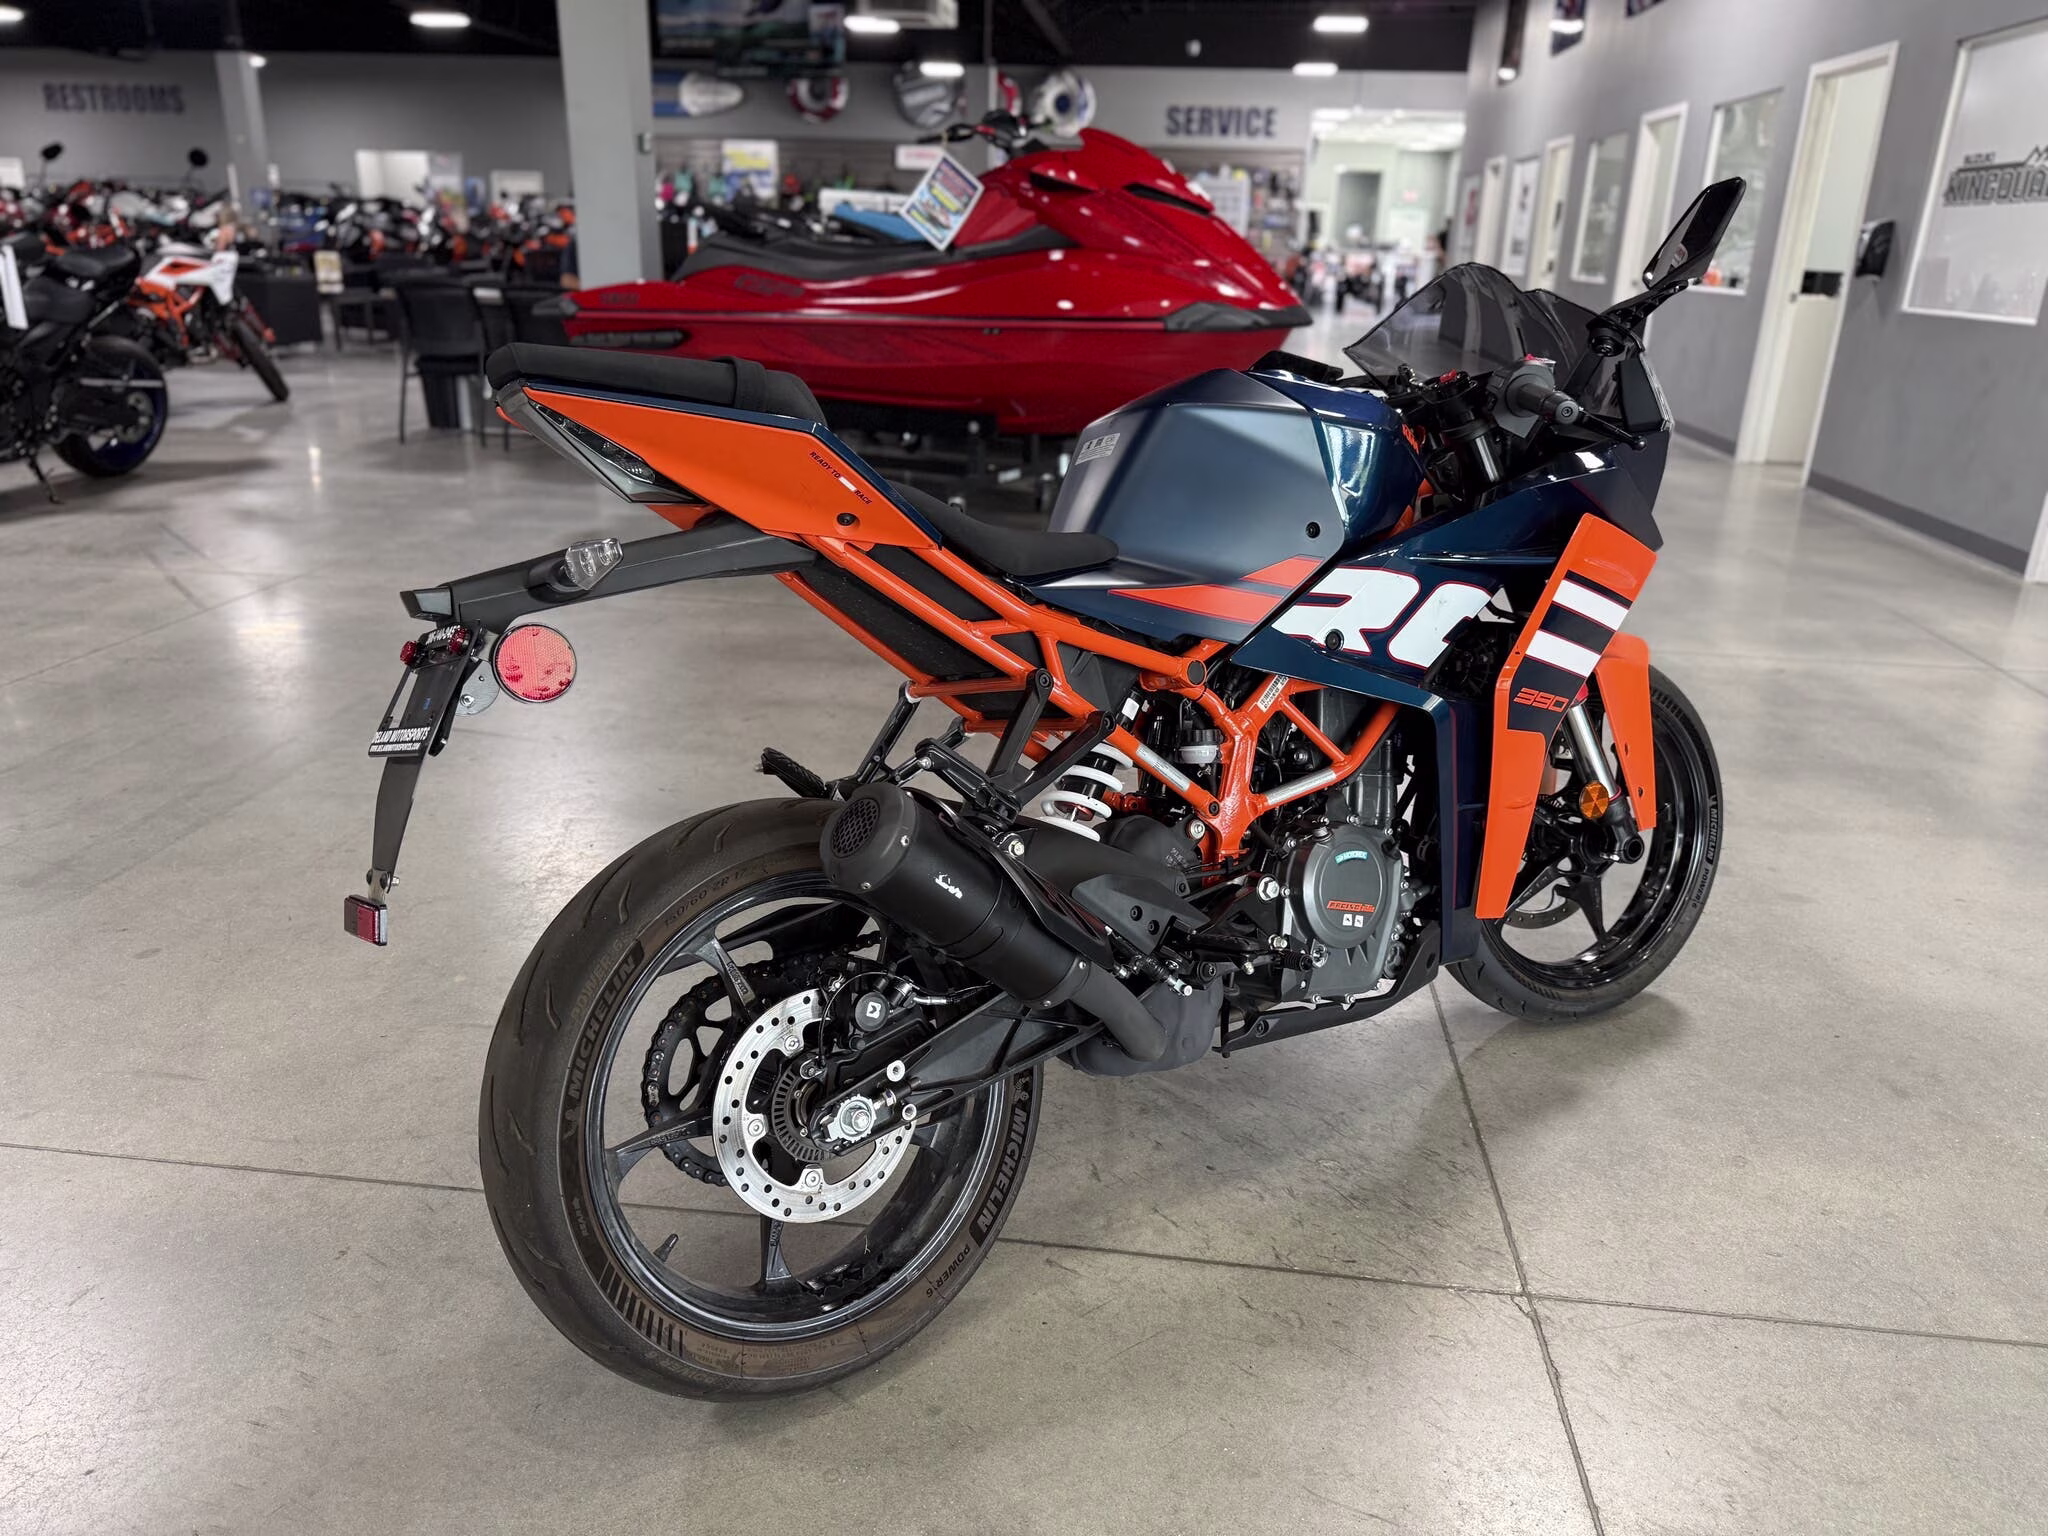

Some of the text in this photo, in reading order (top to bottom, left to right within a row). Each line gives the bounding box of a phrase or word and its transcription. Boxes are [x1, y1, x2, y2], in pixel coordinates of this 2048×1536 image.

[43, 82, 185, 116] RESTROOMS
[1166, 105, 1279, 138] SERVICE
[810, 451, 873, 505] READY TO RACE
[1513, 687, 1569, 713] 390
[389, 726, 431, 742] MOTORSPORTS
[1707, 808, 1719, 861] MICHELIN
[1695, 867, 1710, 900] POWER
[569, 953, 613, 1021] POWER
[568, 956, 639, 1096] MICHELIN
[976, 1107, 1028, 1233] MICHELIN
[936, 1243, 970, 1288] POWER
